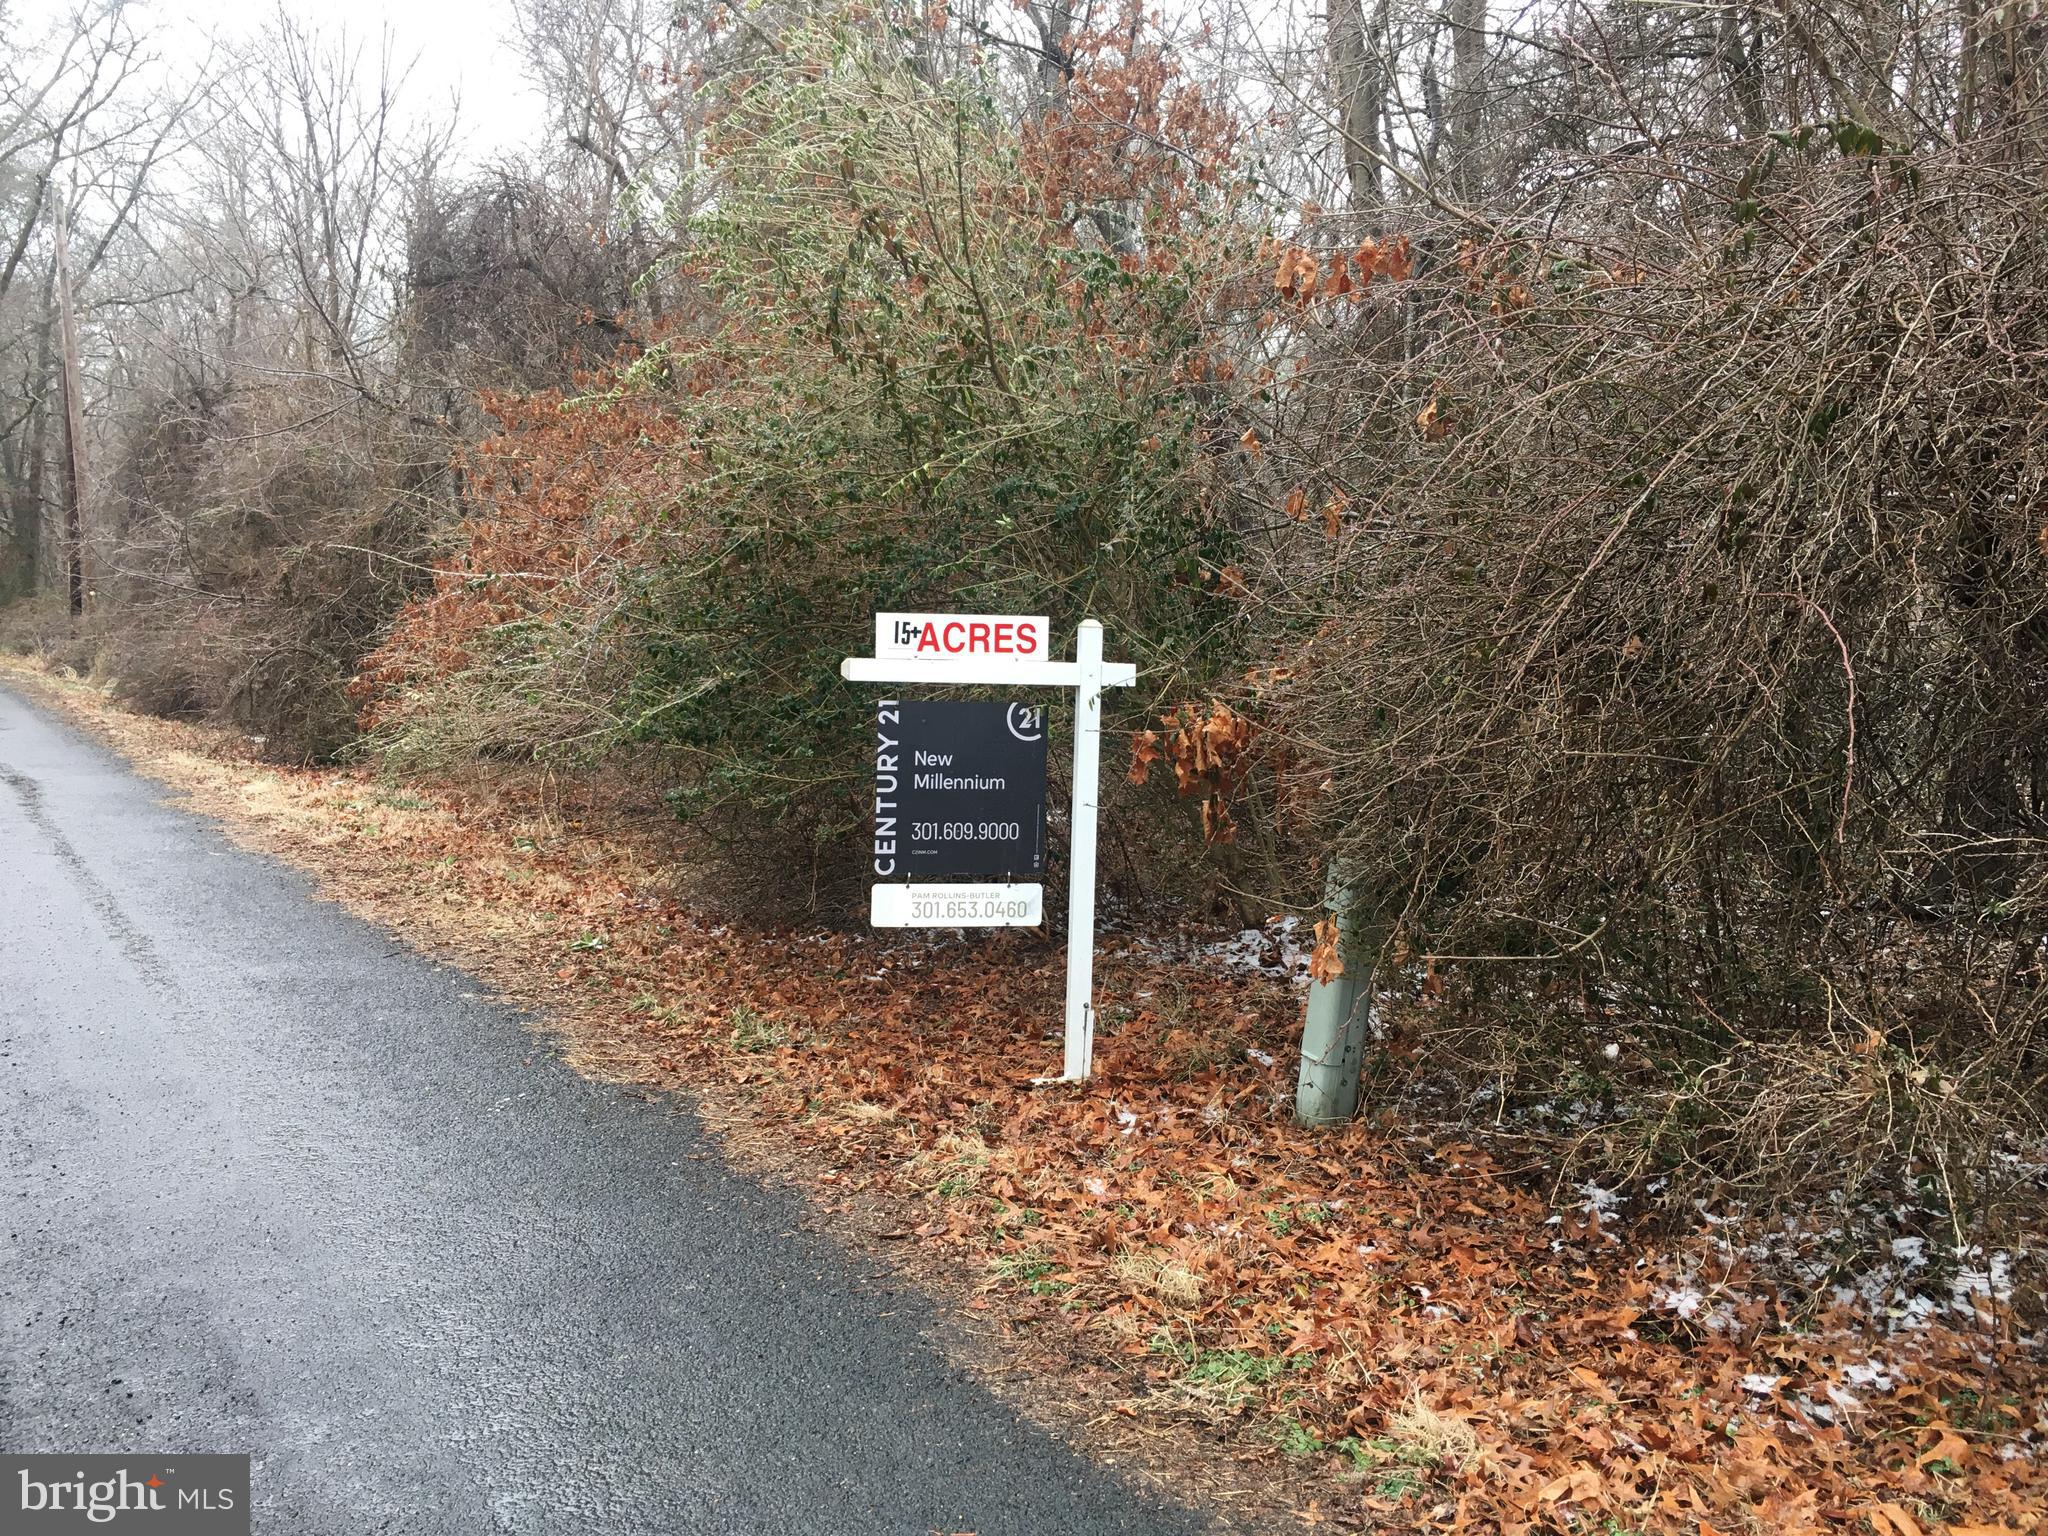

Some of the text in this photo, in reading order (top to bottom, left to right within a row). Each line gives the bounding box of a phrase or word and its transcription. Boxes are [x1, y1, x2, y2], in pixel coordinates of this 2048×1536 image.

[894, 620, 1037, 654] 15+ ACRES
[914, 750, 953, 767] New
[874, 700, 900, 876] CENTURY 21
[913, 773, 1006, 790] Millennium
[911, 822, 1019, 841] 301.609.9000
[911, 901, 1027, 919] 301.653.0460
